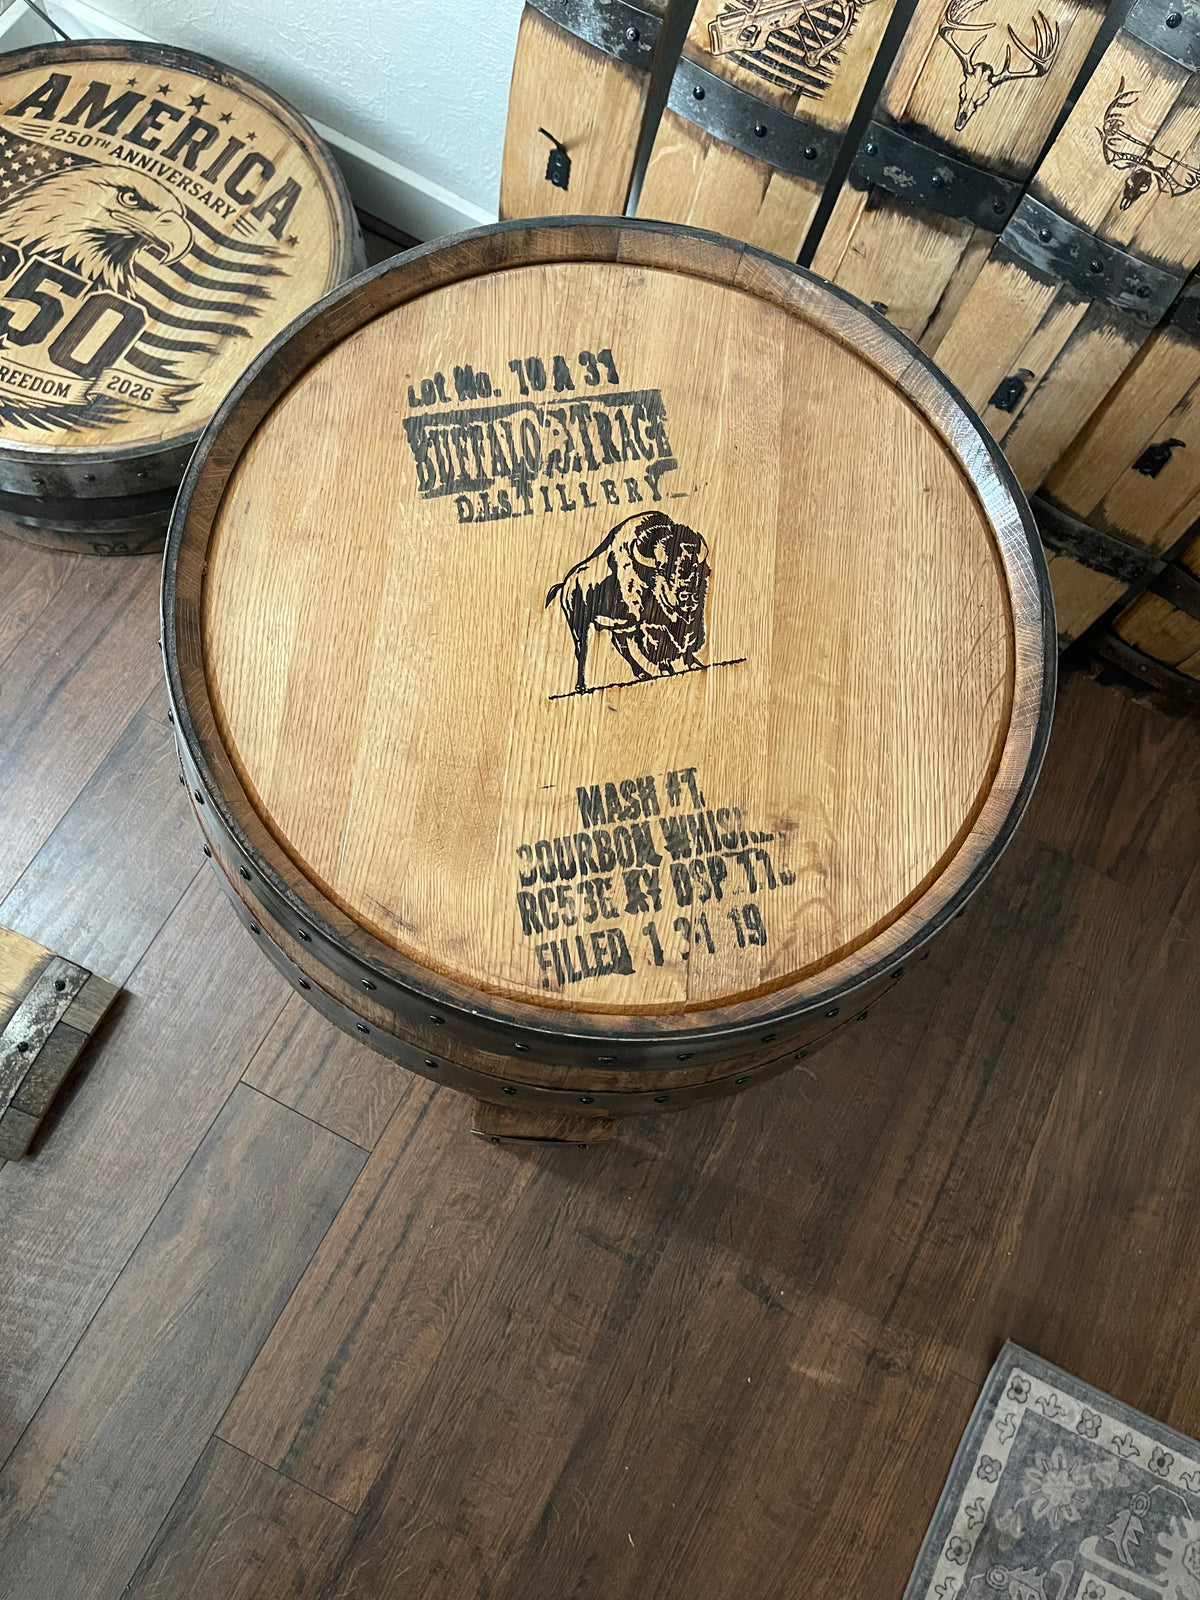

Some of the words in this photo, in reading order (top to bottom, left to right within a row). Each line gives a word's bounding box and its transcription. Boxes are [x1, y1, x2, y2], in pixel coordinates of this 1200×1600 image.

[5, 72, 303, 241] AMERICA
[50, 128, 112, 148] 250TH
[108, 145, 237, 221] ANNIVERSARY
[0, 242, 147, 379] 50
[106, 375, 154, 402] 2026
[455, 474, 663, 523] DISTILLERY
[576, 775, 660, 829] MASH
[516, 821, 662, 888] BOURBON
[535, 928, 636, 987] FILLED
